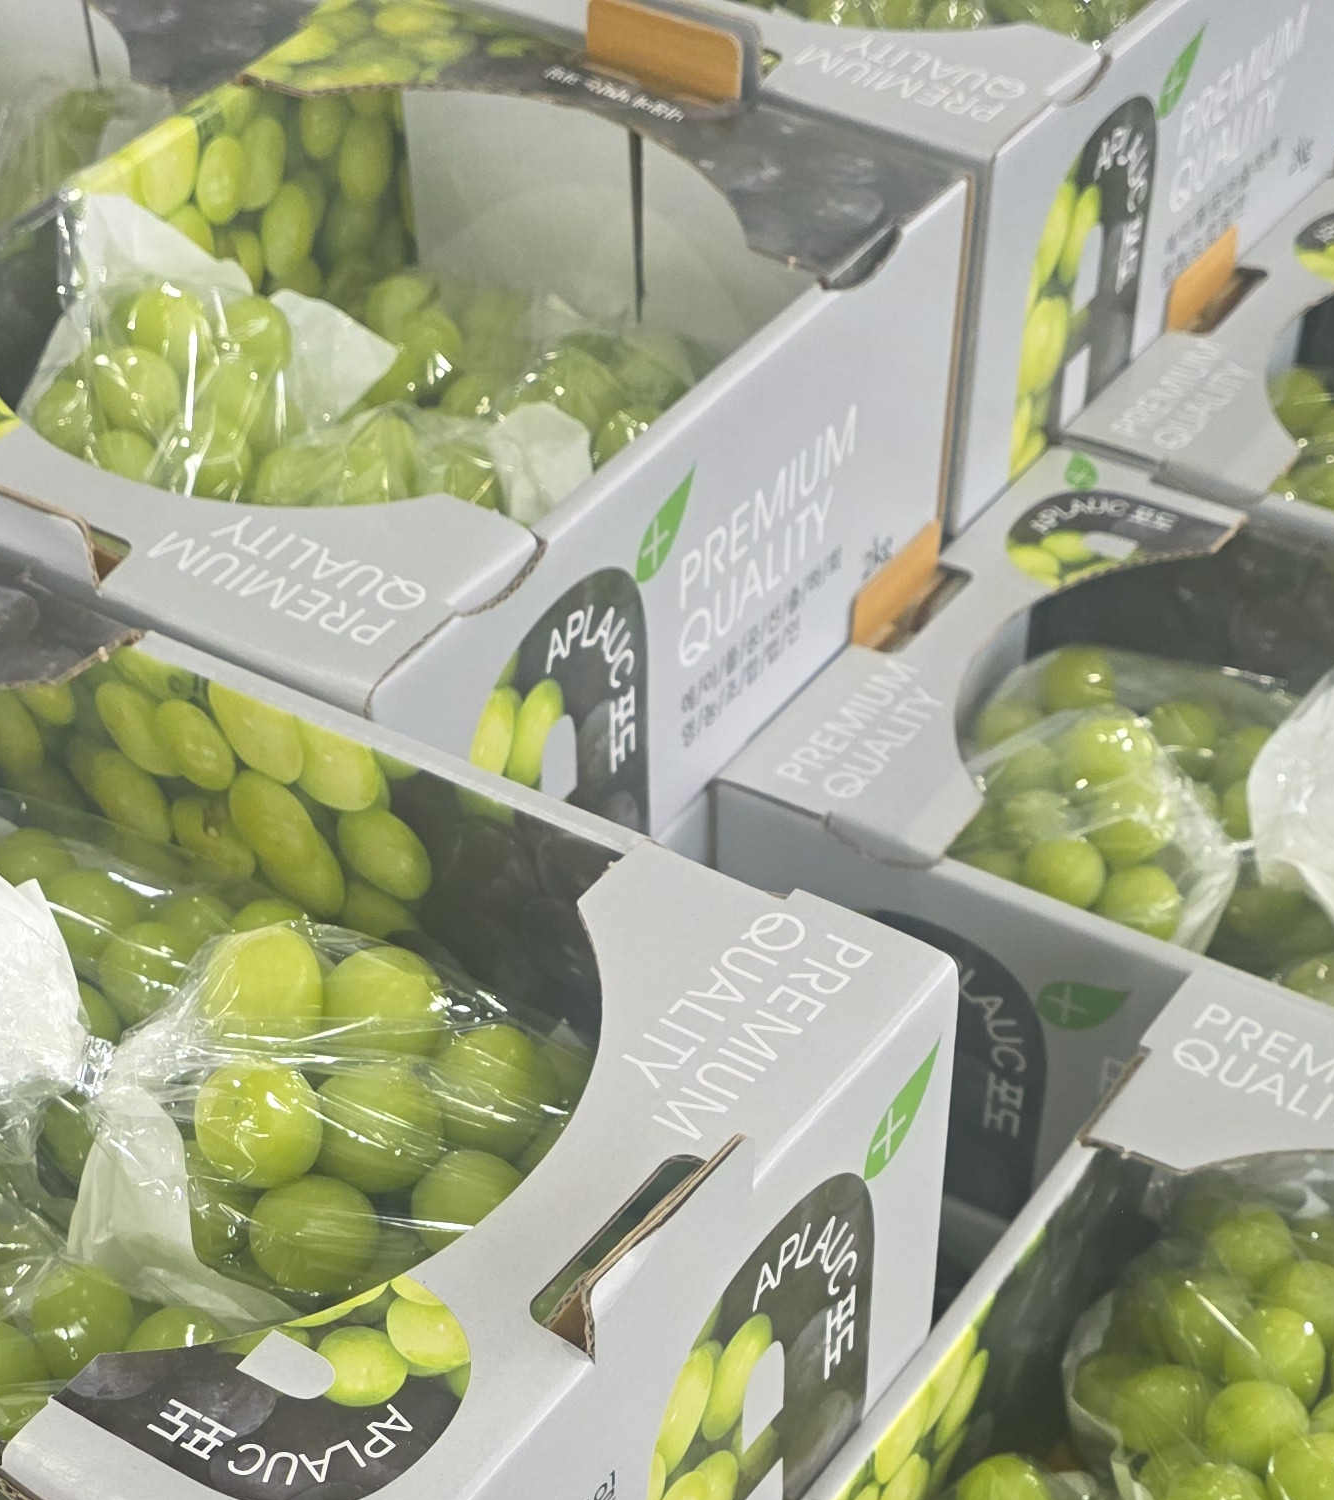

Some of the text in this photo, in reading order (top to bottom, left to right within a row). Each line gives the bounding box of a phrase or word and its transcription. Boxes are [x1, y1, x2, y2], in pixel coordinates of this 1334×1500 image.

[794, 43, 1007, 123] PREMIUM
[844, 35, 1027, 100] QUALITY
[210, 515, 426, 610] QUALITY
[679, 403, 858, 611] PREMIUM
[147, 531, 397, 646] PREMIUM
[678, 485, 835, 668] QUALITY
[546, 604, 636, 774] APLAUC 포도
[774, 658, 920, 785] PREMIUM
[822, 685, 944, 799] QUALITY
[622, 912, 806, 1089] QUALITY
[651, 932, 874, 1141] PREMIUM
[983, 1071, 1025, 1138] 포도
[752, 1215, 857, 1380] APLAUC 포도
[146, 1398, 414, 1486] APLAUC 포도
